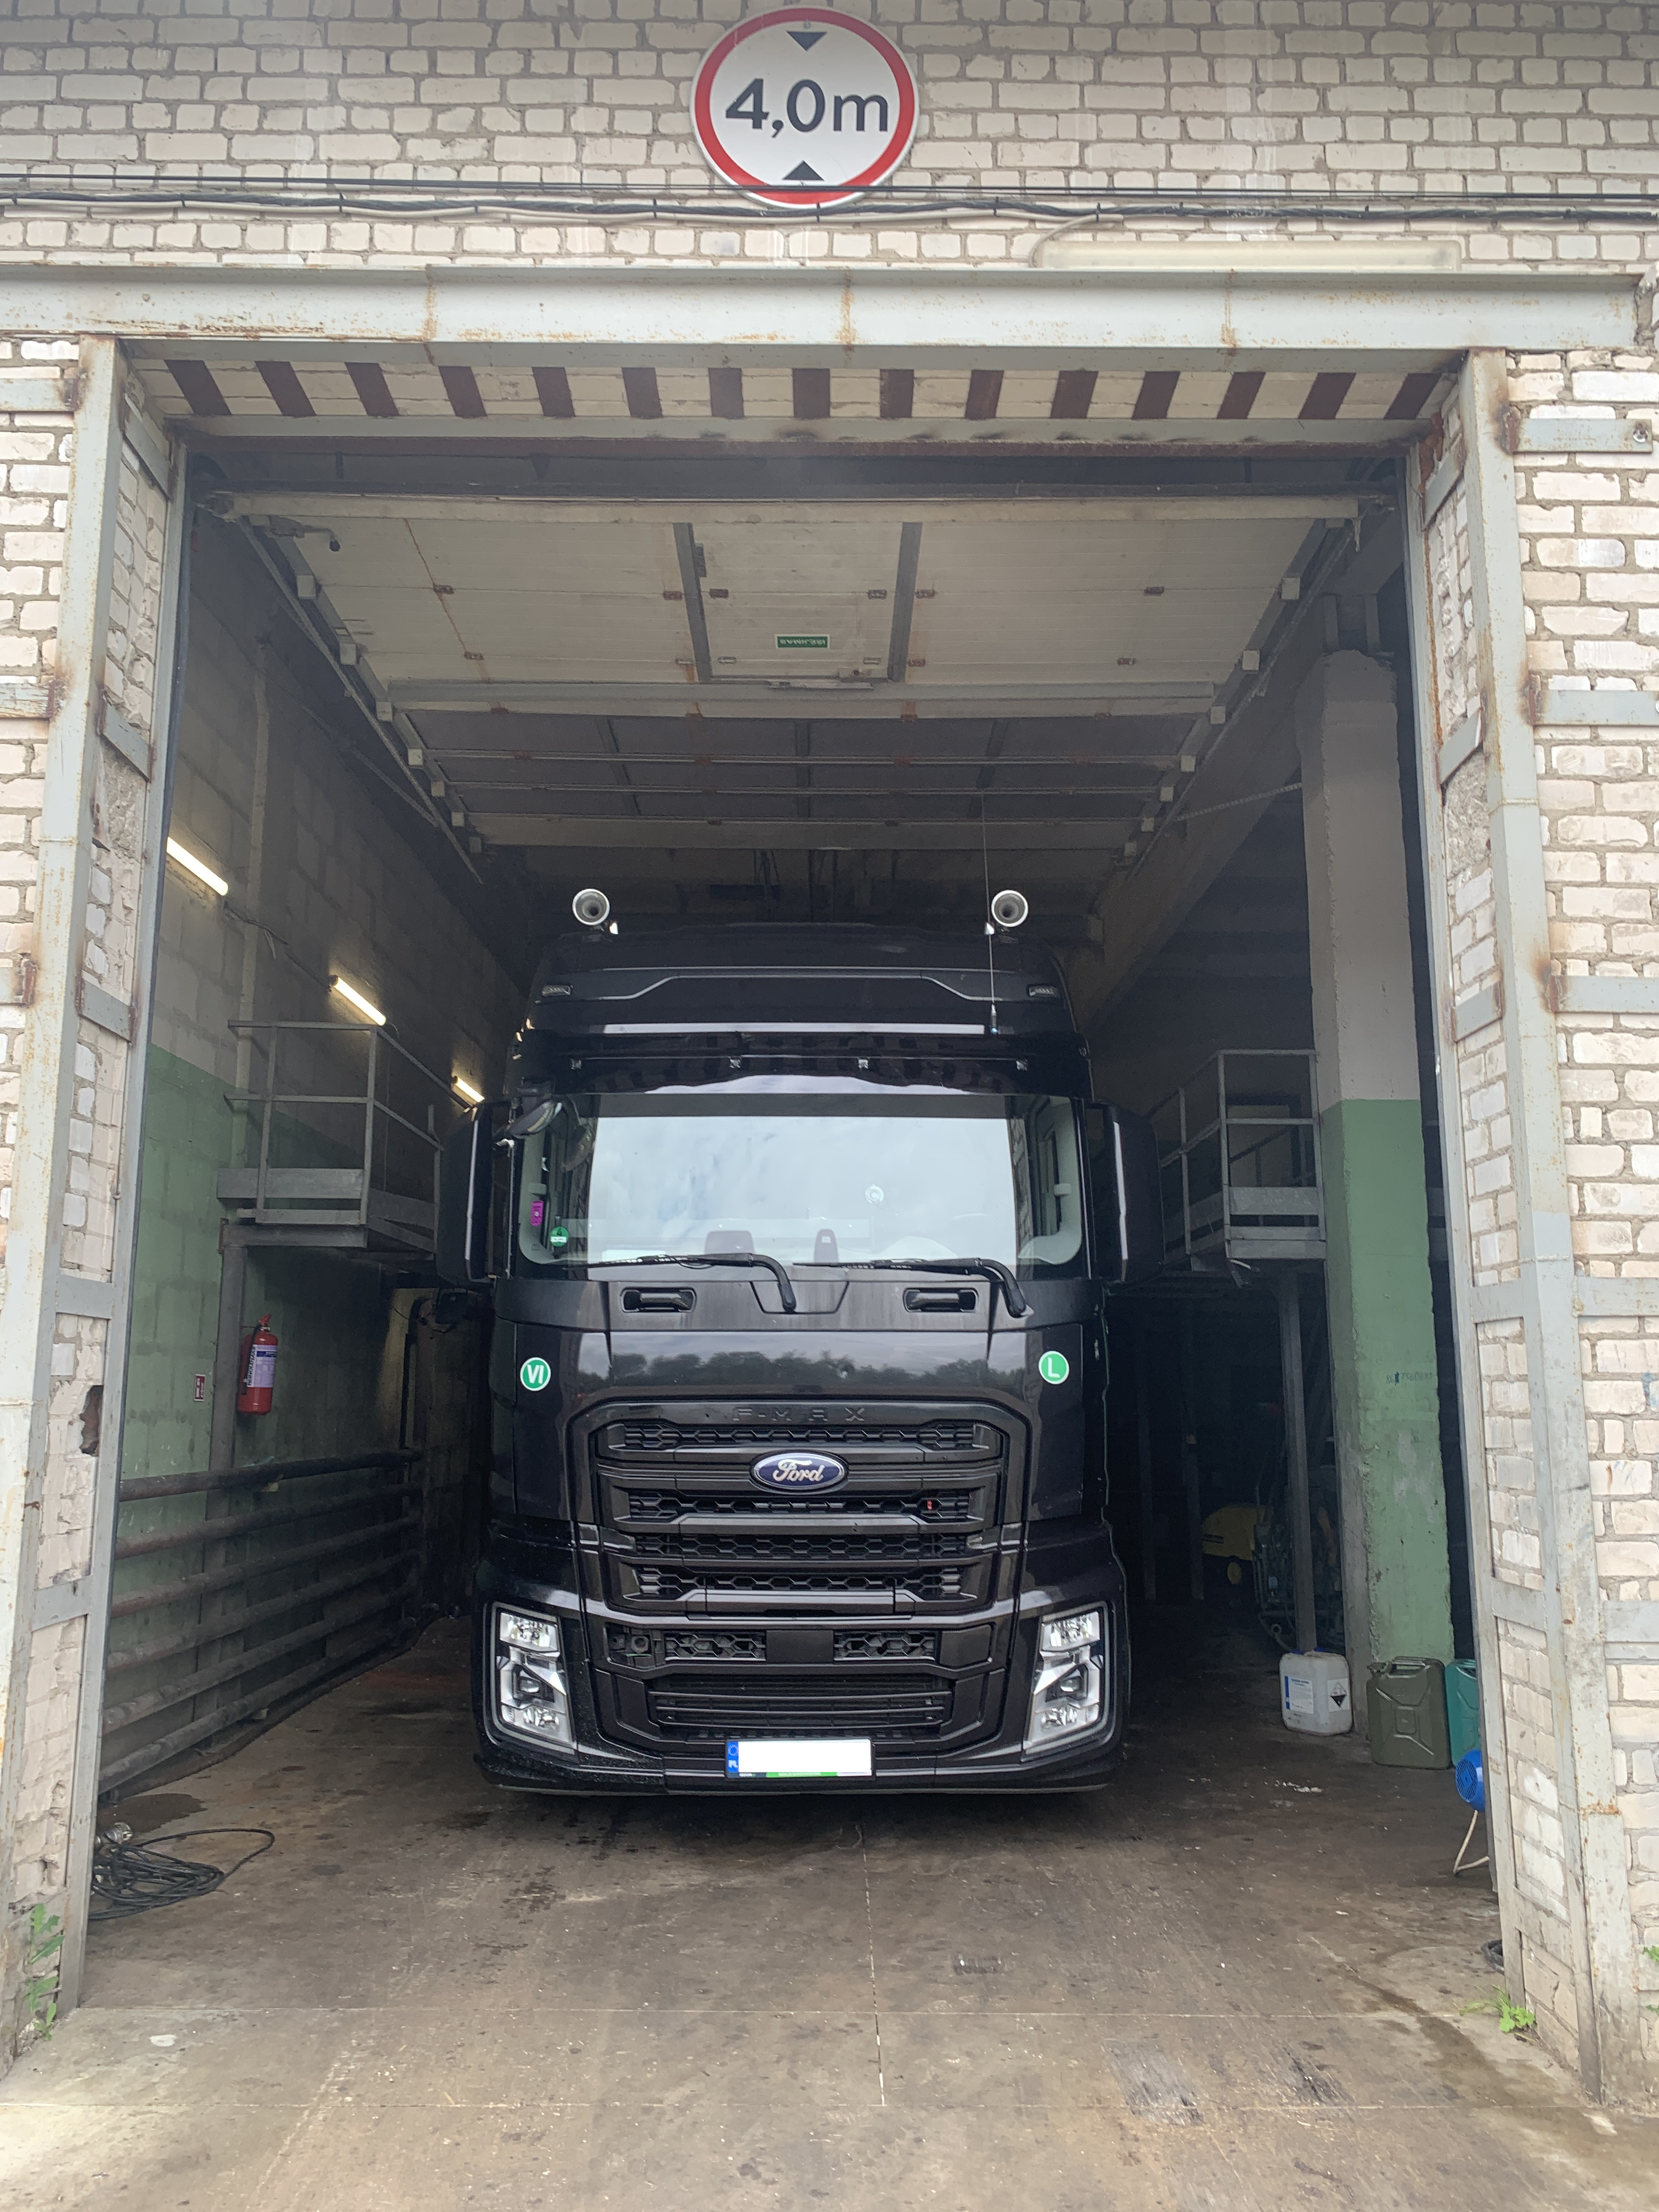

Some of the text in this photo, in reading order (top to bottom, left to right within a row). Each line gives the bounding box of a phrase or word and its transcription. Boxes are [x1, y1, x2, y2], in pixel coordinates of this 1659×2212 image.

[725, 77, 888, 138] 4,0m
[527, 1364, 545, 1384] VI
[1047, 1357, 1060, 1378] L
[732, 1407, 866, 1421] F-MAX
[772, 1458, 825, 1482] Ford
